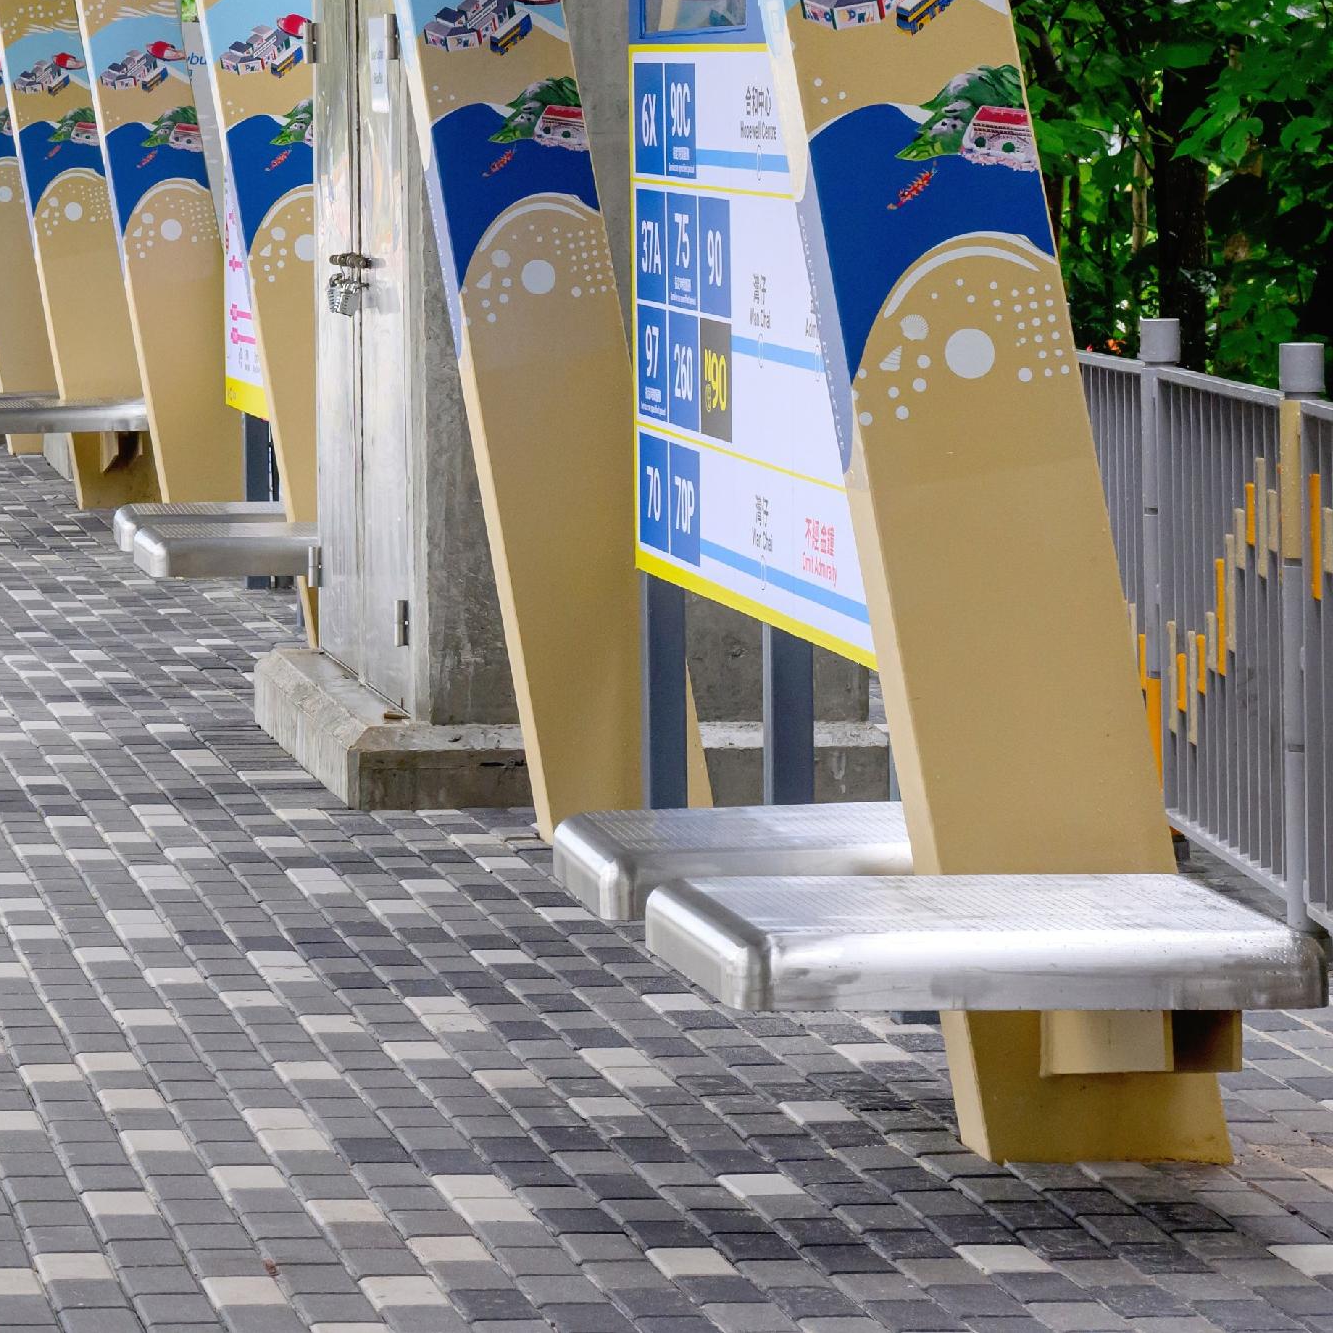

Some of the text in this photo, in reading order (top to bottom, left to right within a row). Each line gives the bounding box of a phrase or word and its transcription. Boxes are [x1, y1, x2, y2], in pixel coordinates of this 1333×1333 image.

[641, 82, 691, 146] 6X 90C
[641, 213, 723, 287] 37A 75 90
[645, 324, 660, 379] 97
[673, 343, 693, 402] 260
[646, 465, 695, 534] 70 70P
